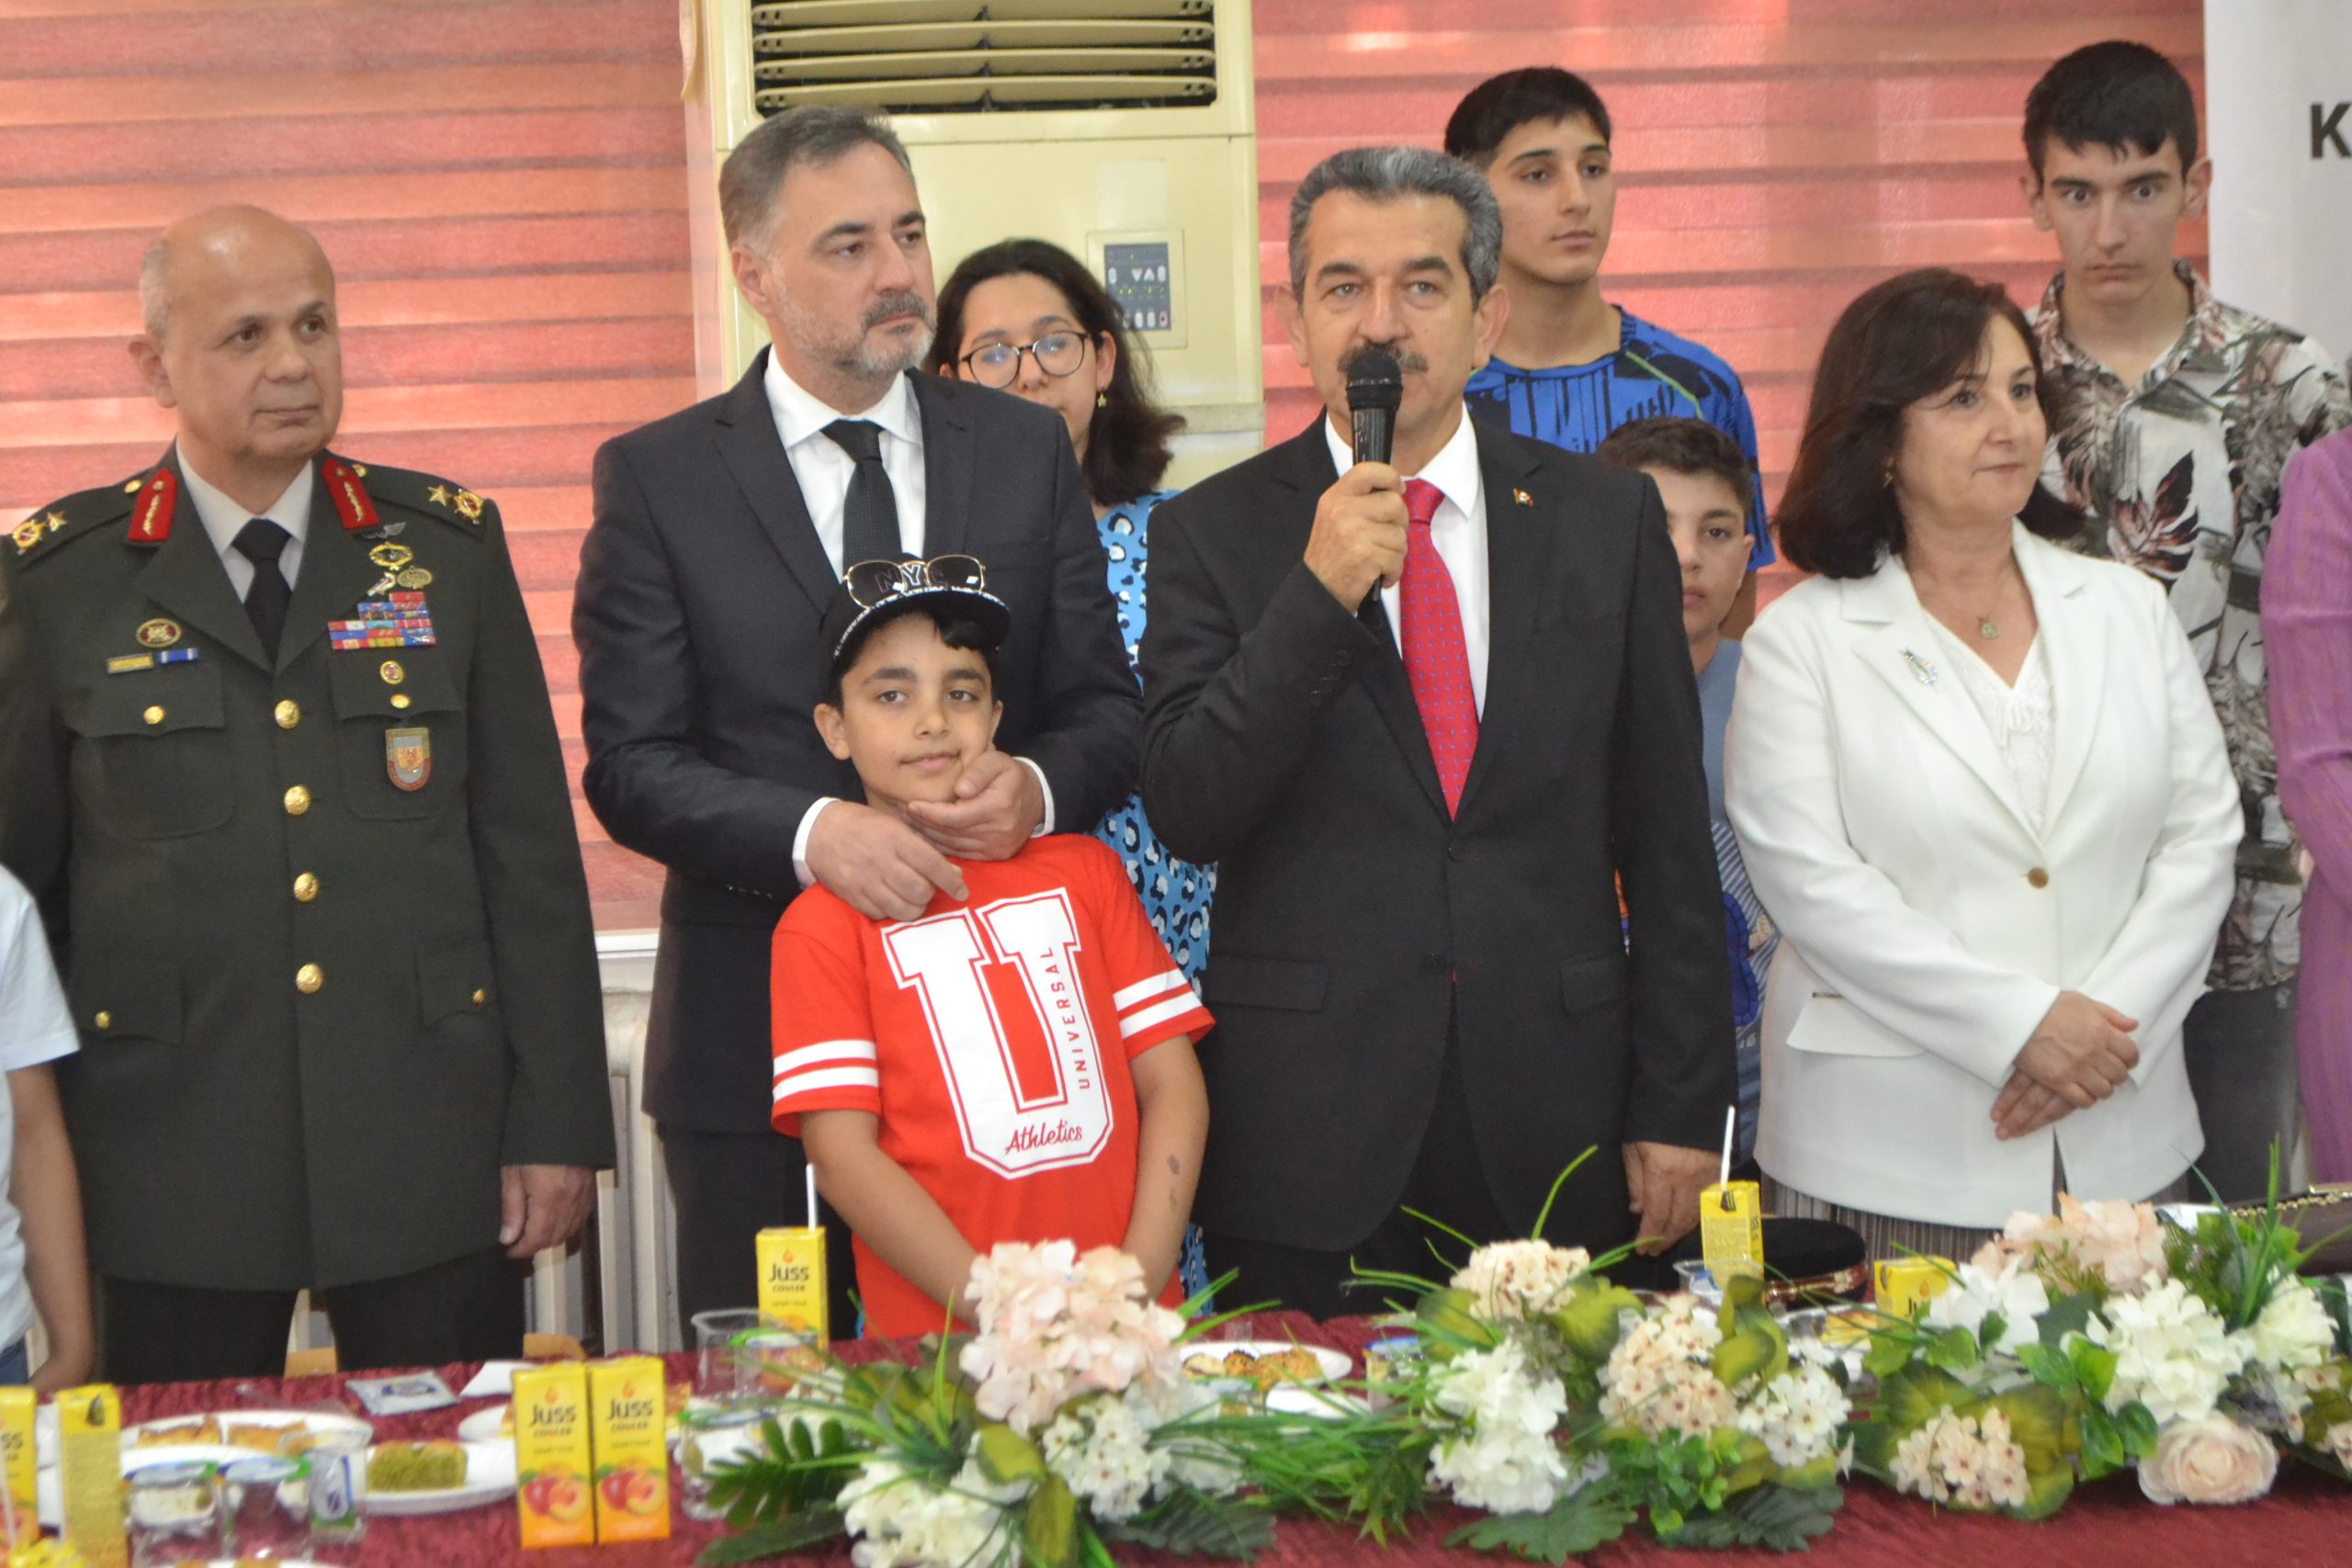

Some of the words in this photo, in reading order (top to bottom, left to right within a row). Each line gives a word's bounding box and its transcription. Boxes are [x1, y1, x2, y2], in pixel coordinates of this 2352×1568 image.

[1040, 947, 1091, 1090] UNIVERSAL
[1004, 1119, 1083, 1156] Athletics
[767, 1263, 809, 1282] Juss
[528, 1404, 577, 1427] Juss
[607, 1398, 654, 1421] Juss
